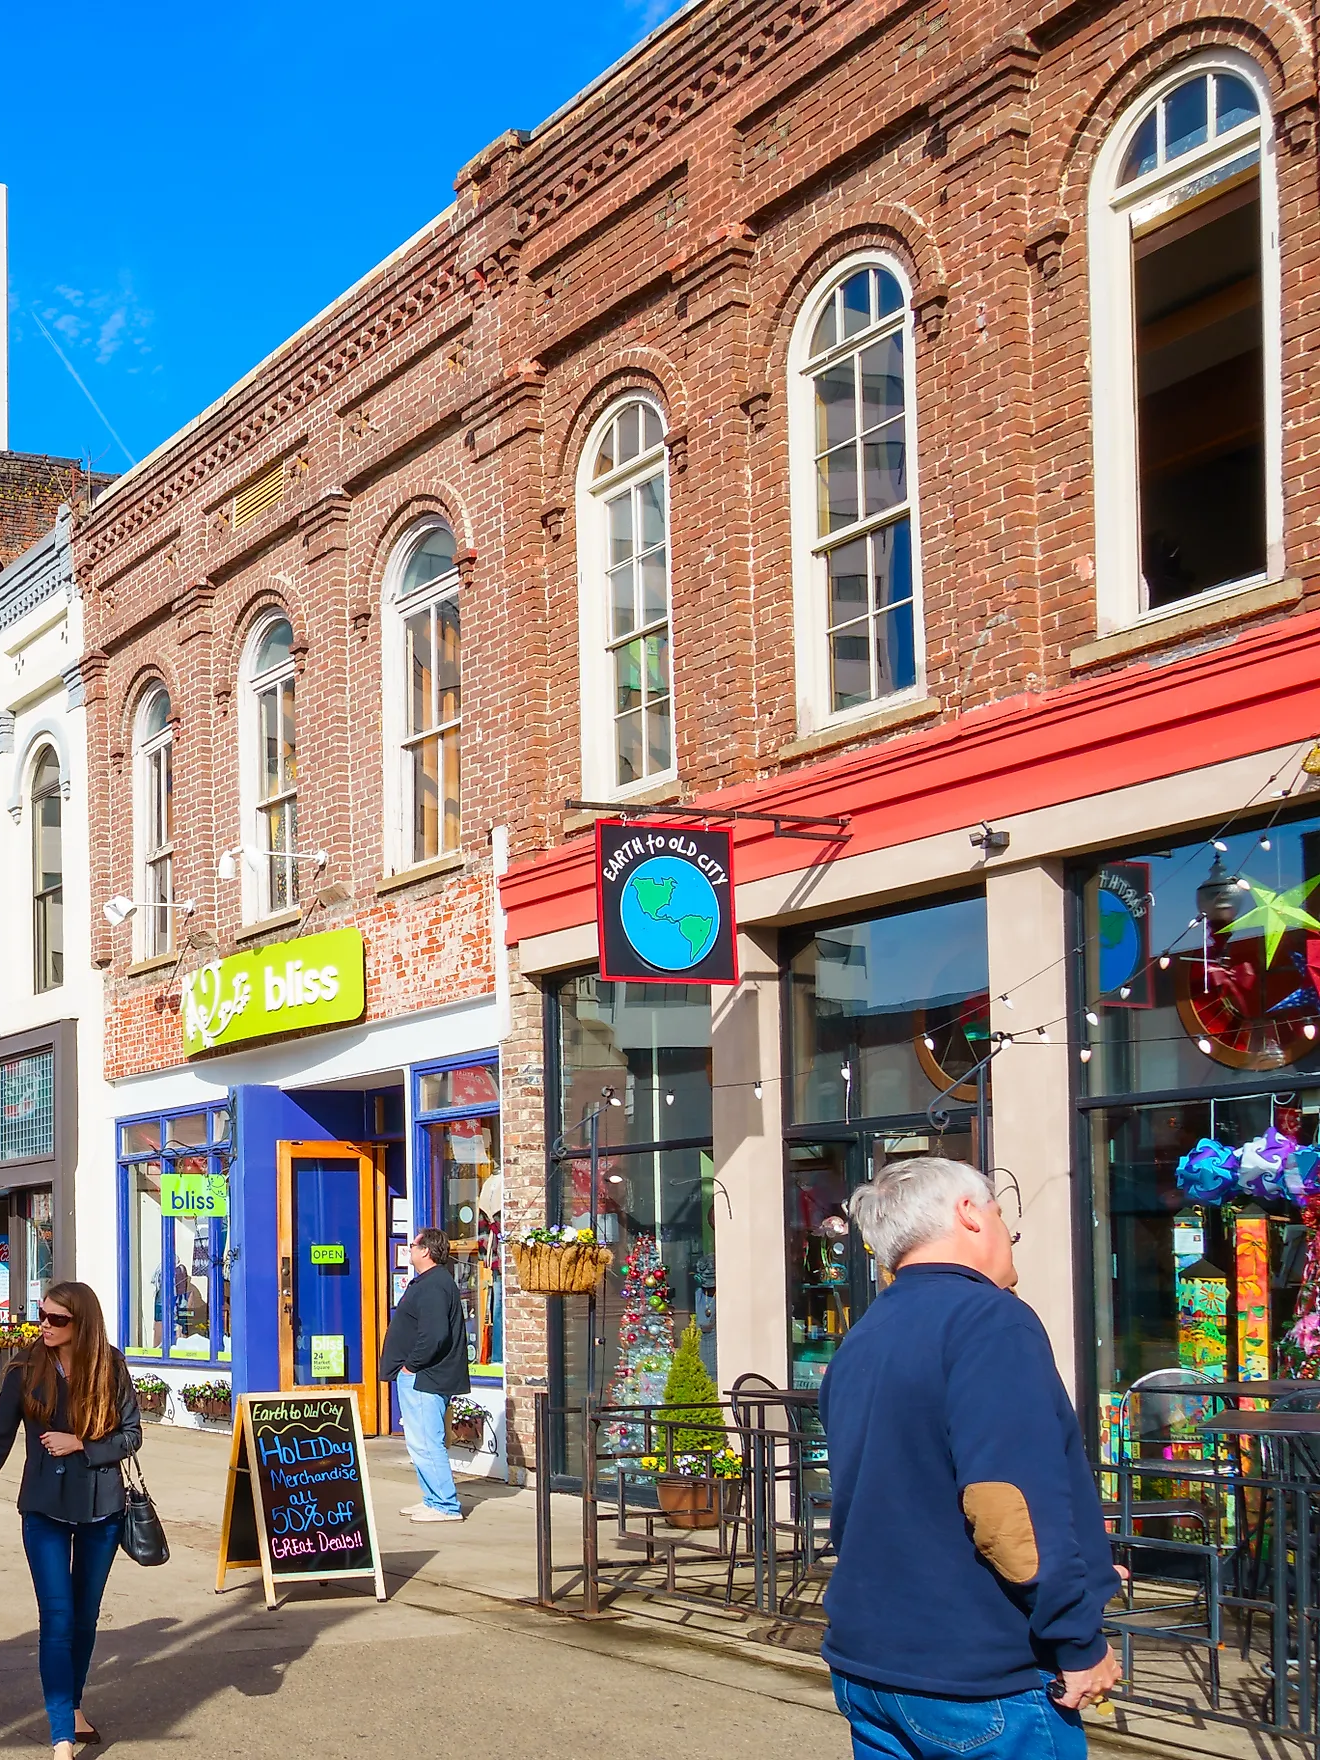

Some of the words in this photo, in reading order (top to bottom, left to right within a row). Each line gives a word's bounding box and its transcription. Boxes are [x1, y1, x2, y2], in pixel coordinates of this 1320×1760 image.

[603, 837, 646, 882] EARTH
[646, 834, 665, 854] to
[697, 854, 728, 886] CITY
[264, 960, 339, 1012] bliss
[171, 1190, 215, 1210] bliss
[313, 1249, 343, 1260] OPEN
[313, 1337, 343, 1351] bliss
[313, 1352, 324, 1360] 24
[252, 1403, 289, 1422] Earth
[289, 1404, 301, 1418] to
[304, 1402, 320, 1419] Old
[321, 1400, 344, 1424] City
[270, 1467, 359, 1491] Merchandise
[289, 1490, 318, 1506] all
[271, 1504, 325, 1534] 50%
[327, 1501, 355, 1525] off
